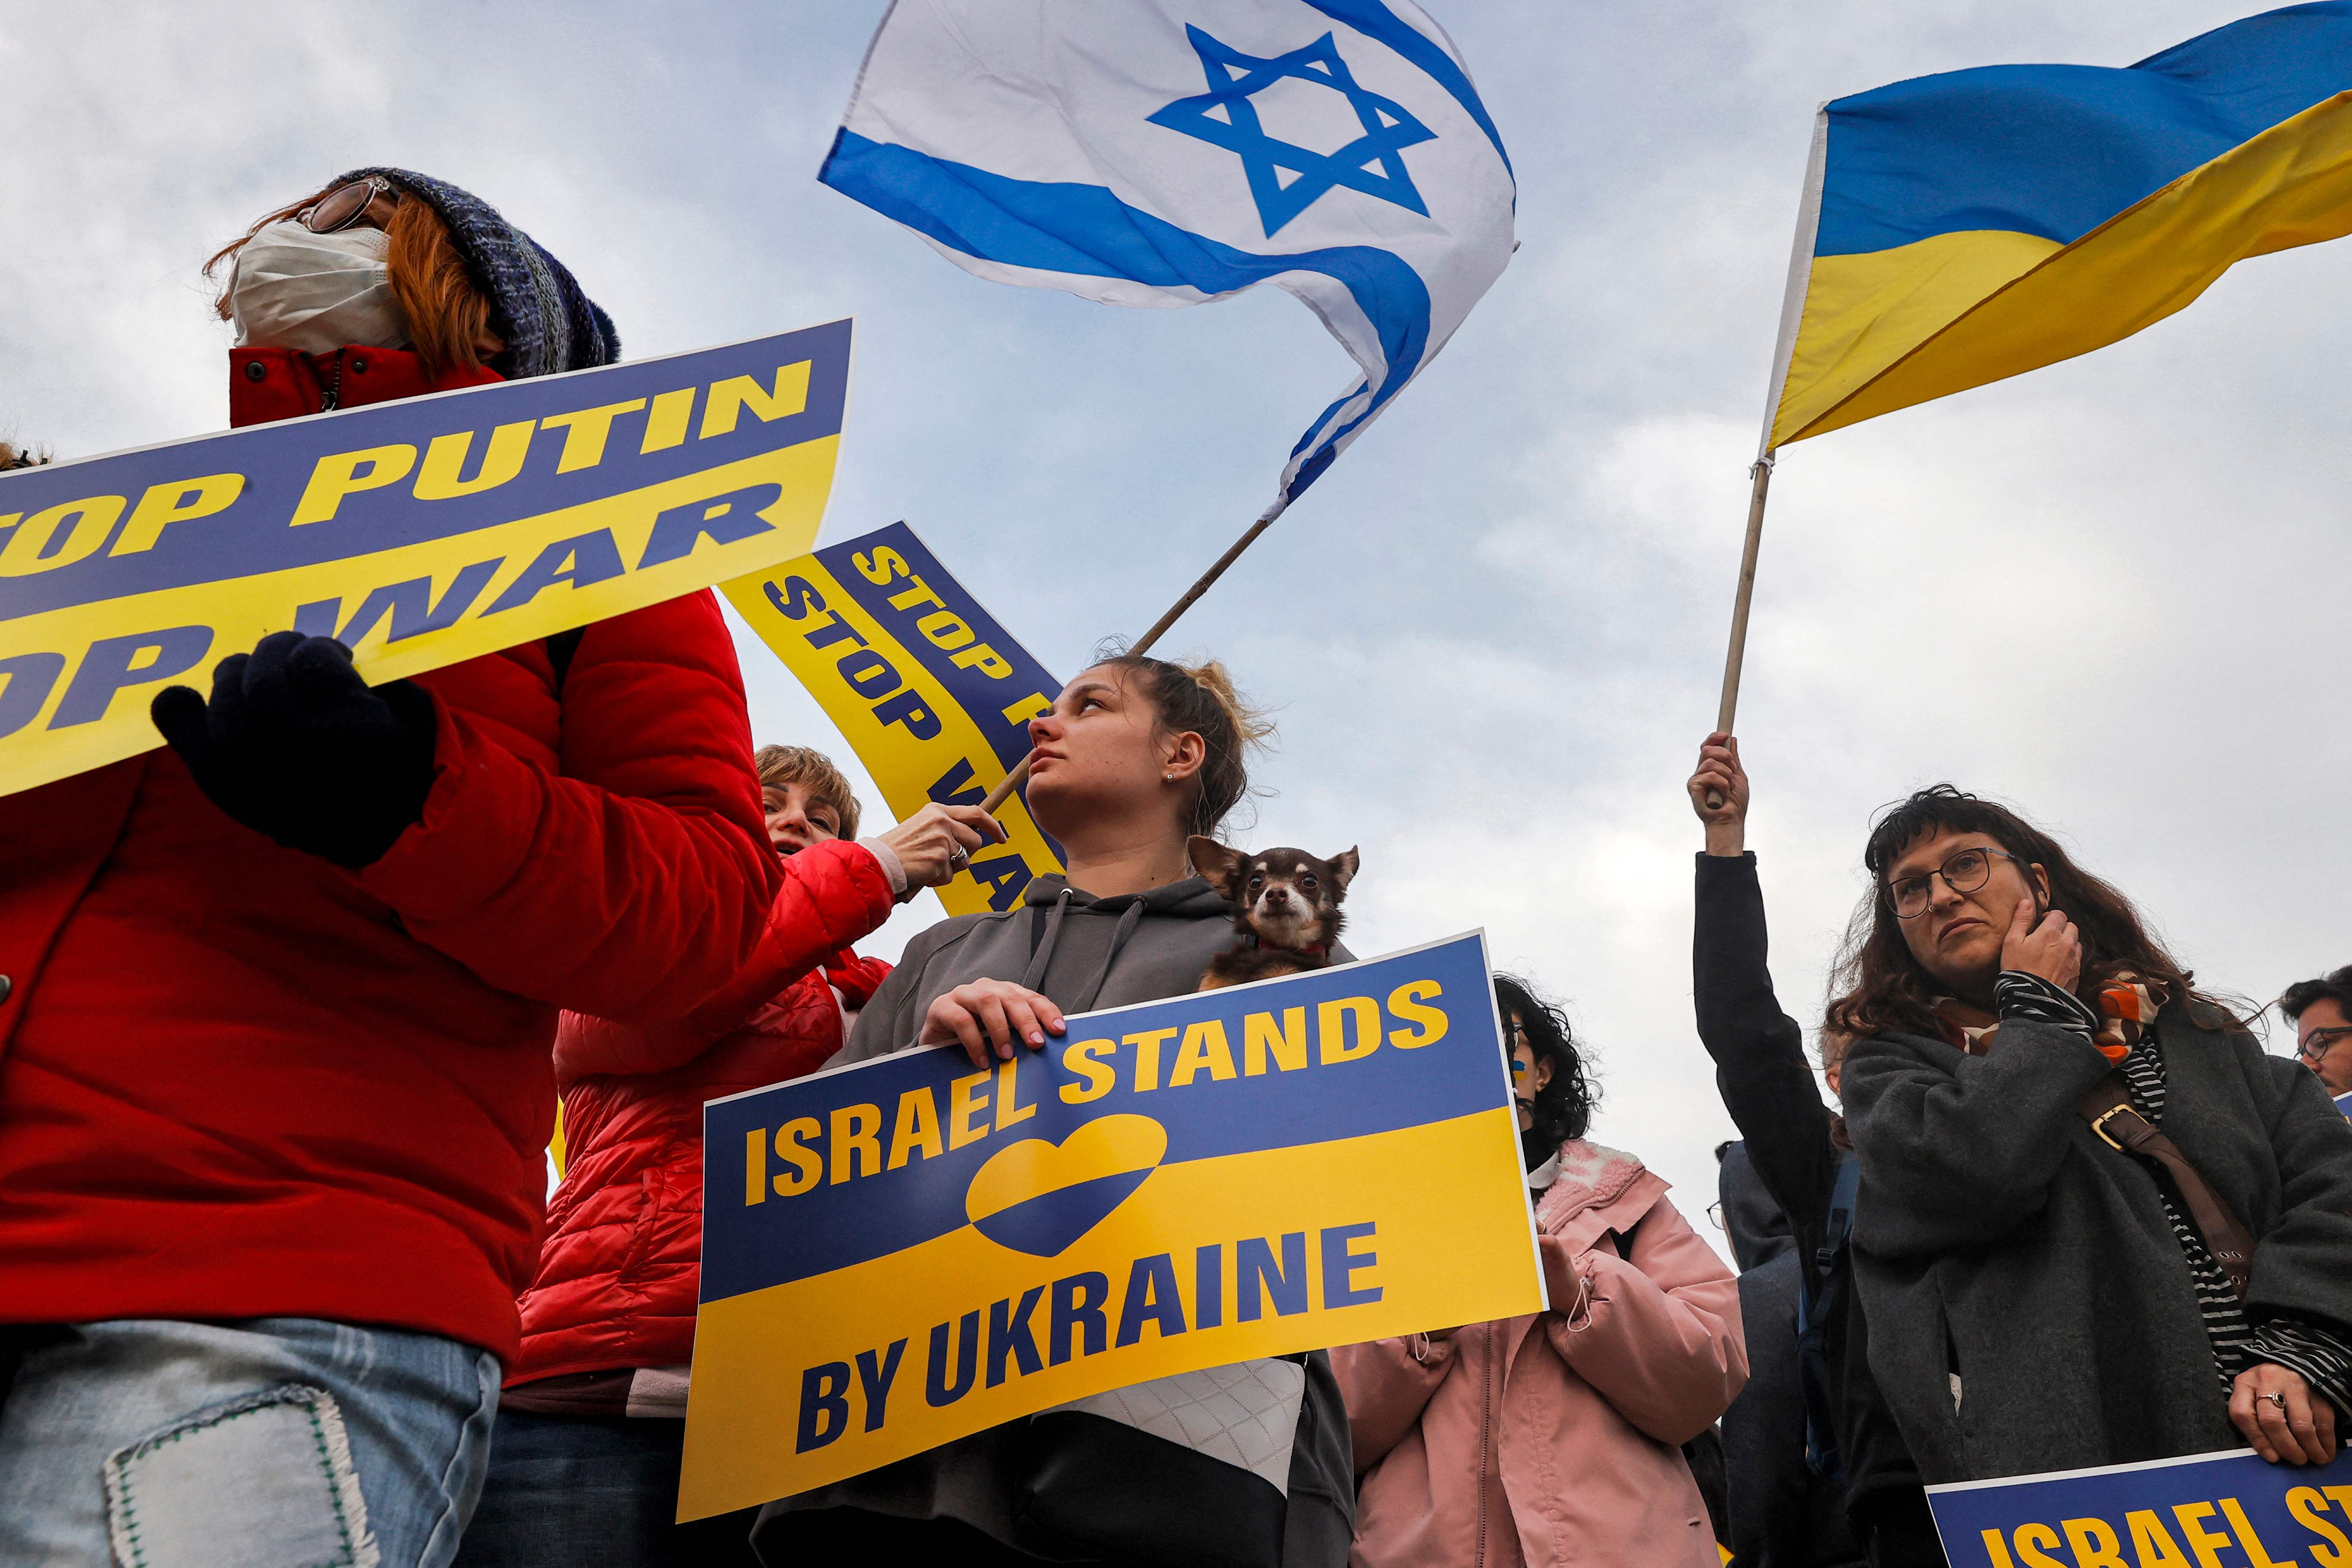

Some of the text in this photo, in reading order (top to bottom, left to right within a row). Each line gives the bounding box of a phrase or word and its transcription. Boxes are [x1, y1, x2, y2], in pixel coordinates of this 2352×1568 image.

[0, 360, 812, 578] OP PUTIN
[293, 483, 782, 650] WAR
[763, 575, 942, 741] STOP
[851, 545, 1013, 680] STOP
[745, 979, 1449, 1207] ISRAEL STANDS
[796, 1222, 1383, 1455] BY UKRAINE
